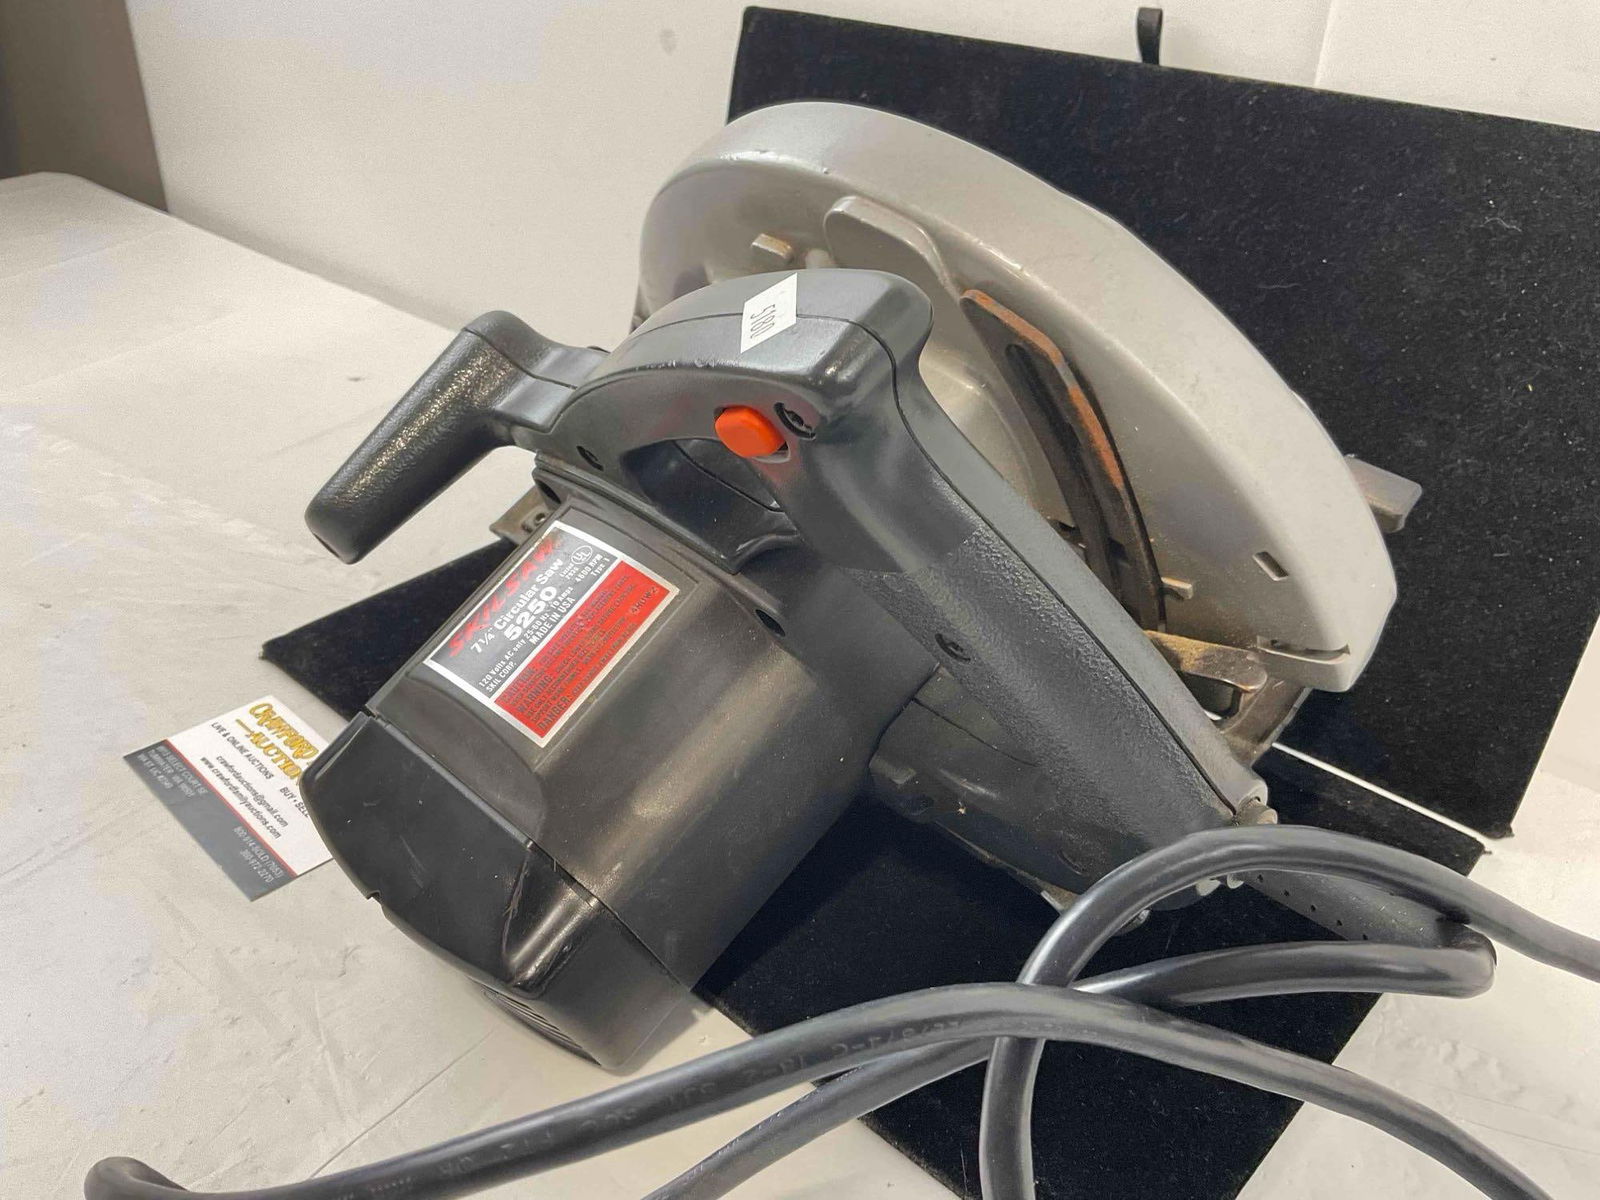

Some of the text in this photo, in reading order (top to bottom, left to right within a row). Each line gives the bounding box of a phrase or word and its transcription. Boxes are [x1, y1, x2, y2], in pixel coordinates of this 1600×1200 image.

[492, 583, 540, 630] Circular
[534, 557, 564, 585] Saw
[573, 552, 604, 583] 4600 RPM
[590, 562, 606, 577] Type
[478, 673, 493, 688] 120
[488, 658, 506, 676] Volts
[502, 649, 515, 661] AC
[511, 637, 527, 653] only
[522, 619, 543, 639] 25-60
[549, 599, 561, 609] 10
[556, 585, 574, 602] Amps
[502, 586, 555, 640] 5250
[528, 595, 576, 645] MADE IN USA
[484, 676, 501, 692] SKIL
[249, 703, 319, 758] CRAWFORD
[211, 721, 226, 733] LIVE
[225, 735, 248, 754] ONLINE
[243, 752, 274, 779] AUCTIONS
[278, 786, 295, 800] BUY
